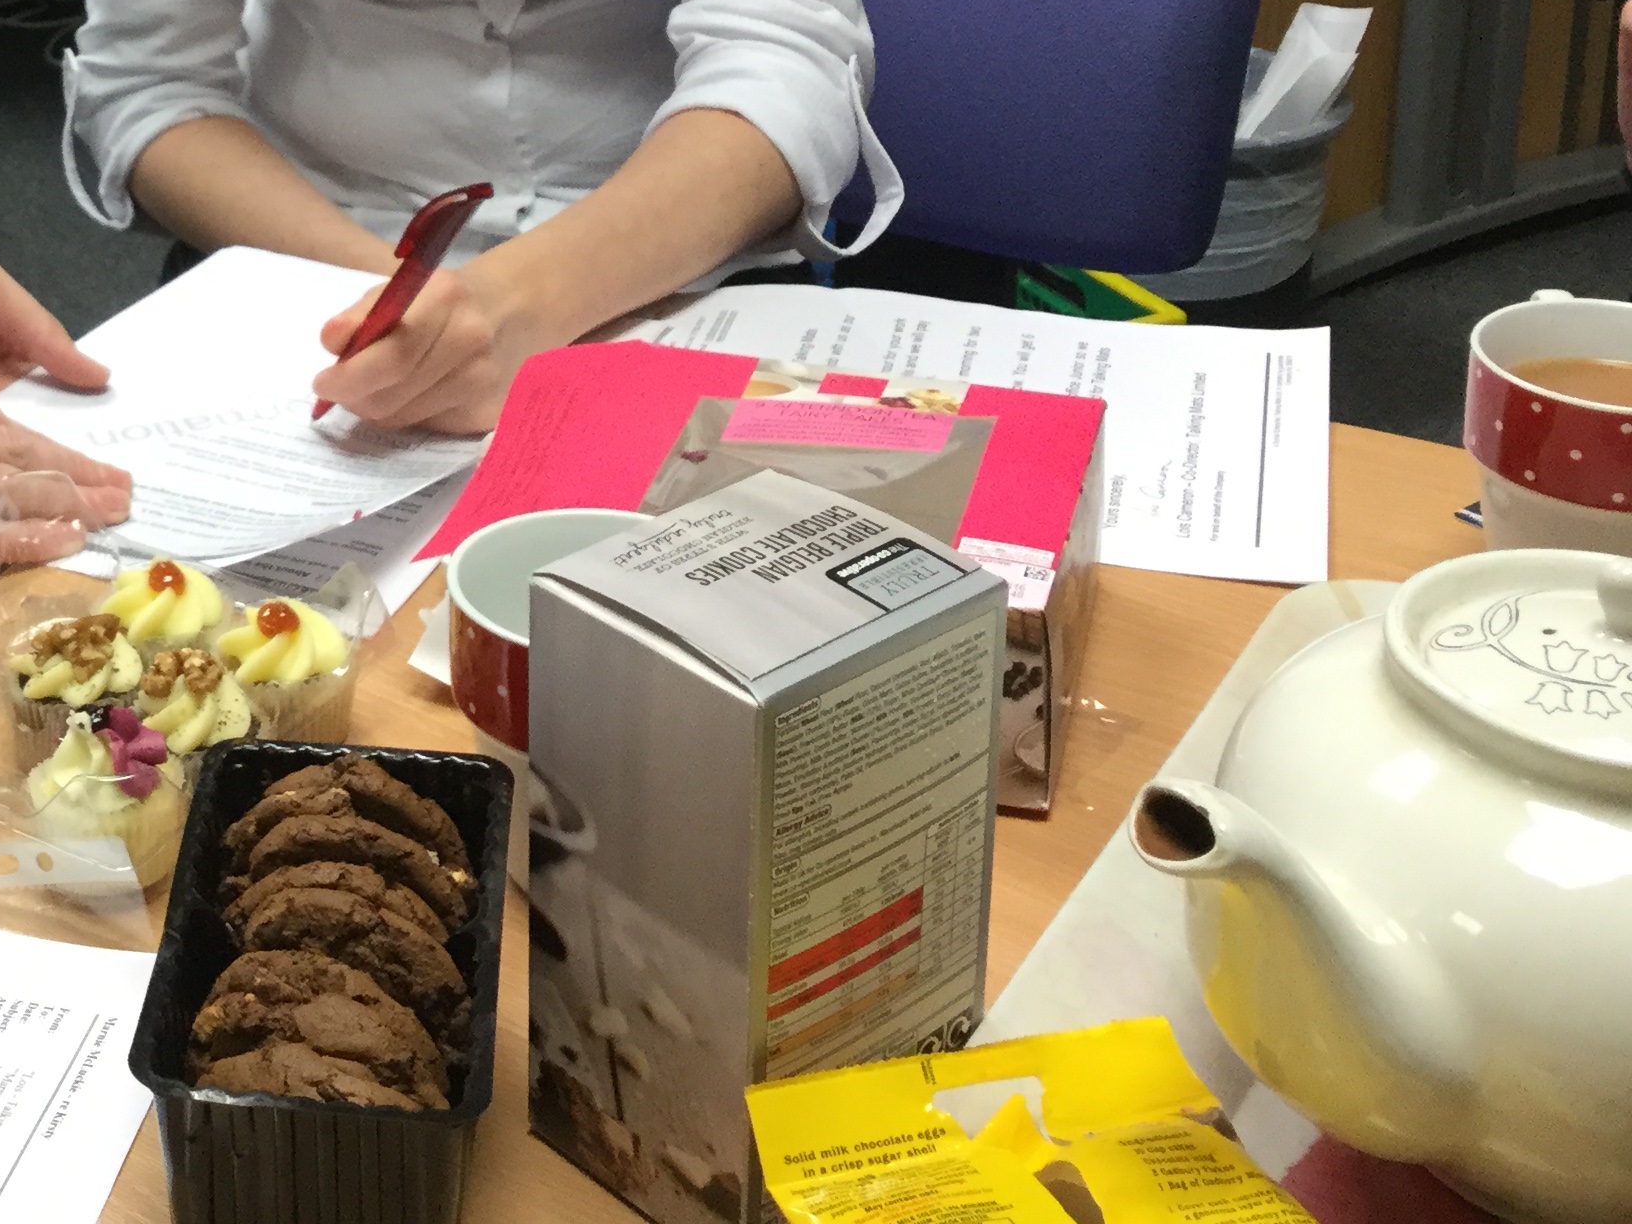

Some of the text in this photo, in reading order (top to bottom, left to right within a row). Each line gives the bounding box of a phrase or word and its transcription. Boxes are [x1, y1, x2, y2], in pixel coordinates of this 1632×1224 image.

[1191, 371, 1208, 395] Limited
[1189, 395, 1205, 414] Mats
[1187, 414, 1205, 438] Talking
[1103, 506, 1119, 528] Yours
[1177, 488, 1195, 521] Cameron
[1175, 521, 1191, 538] Lois
[683, 503, 857, 589] CHOCOLATE COOKIES
[750, 516, 888, 585] TRIPLE BELGIAN
[886, 541, 909, 554] The
[877, 564, 940, 597] TRULY
[17, 1002, 39, 1024] Date:
[46, 1007, 70, 1034] From:
[38, 1016, 119, 1139] Marnie McLuckie re Kirsty
[784, 1127, 947, 1166] Solid milk chocolate eggs
[803, 1166, 815, 1178] in
[831, 1158, 863, 1173] crisp
[868, 1153, 902, 1166] sugar
